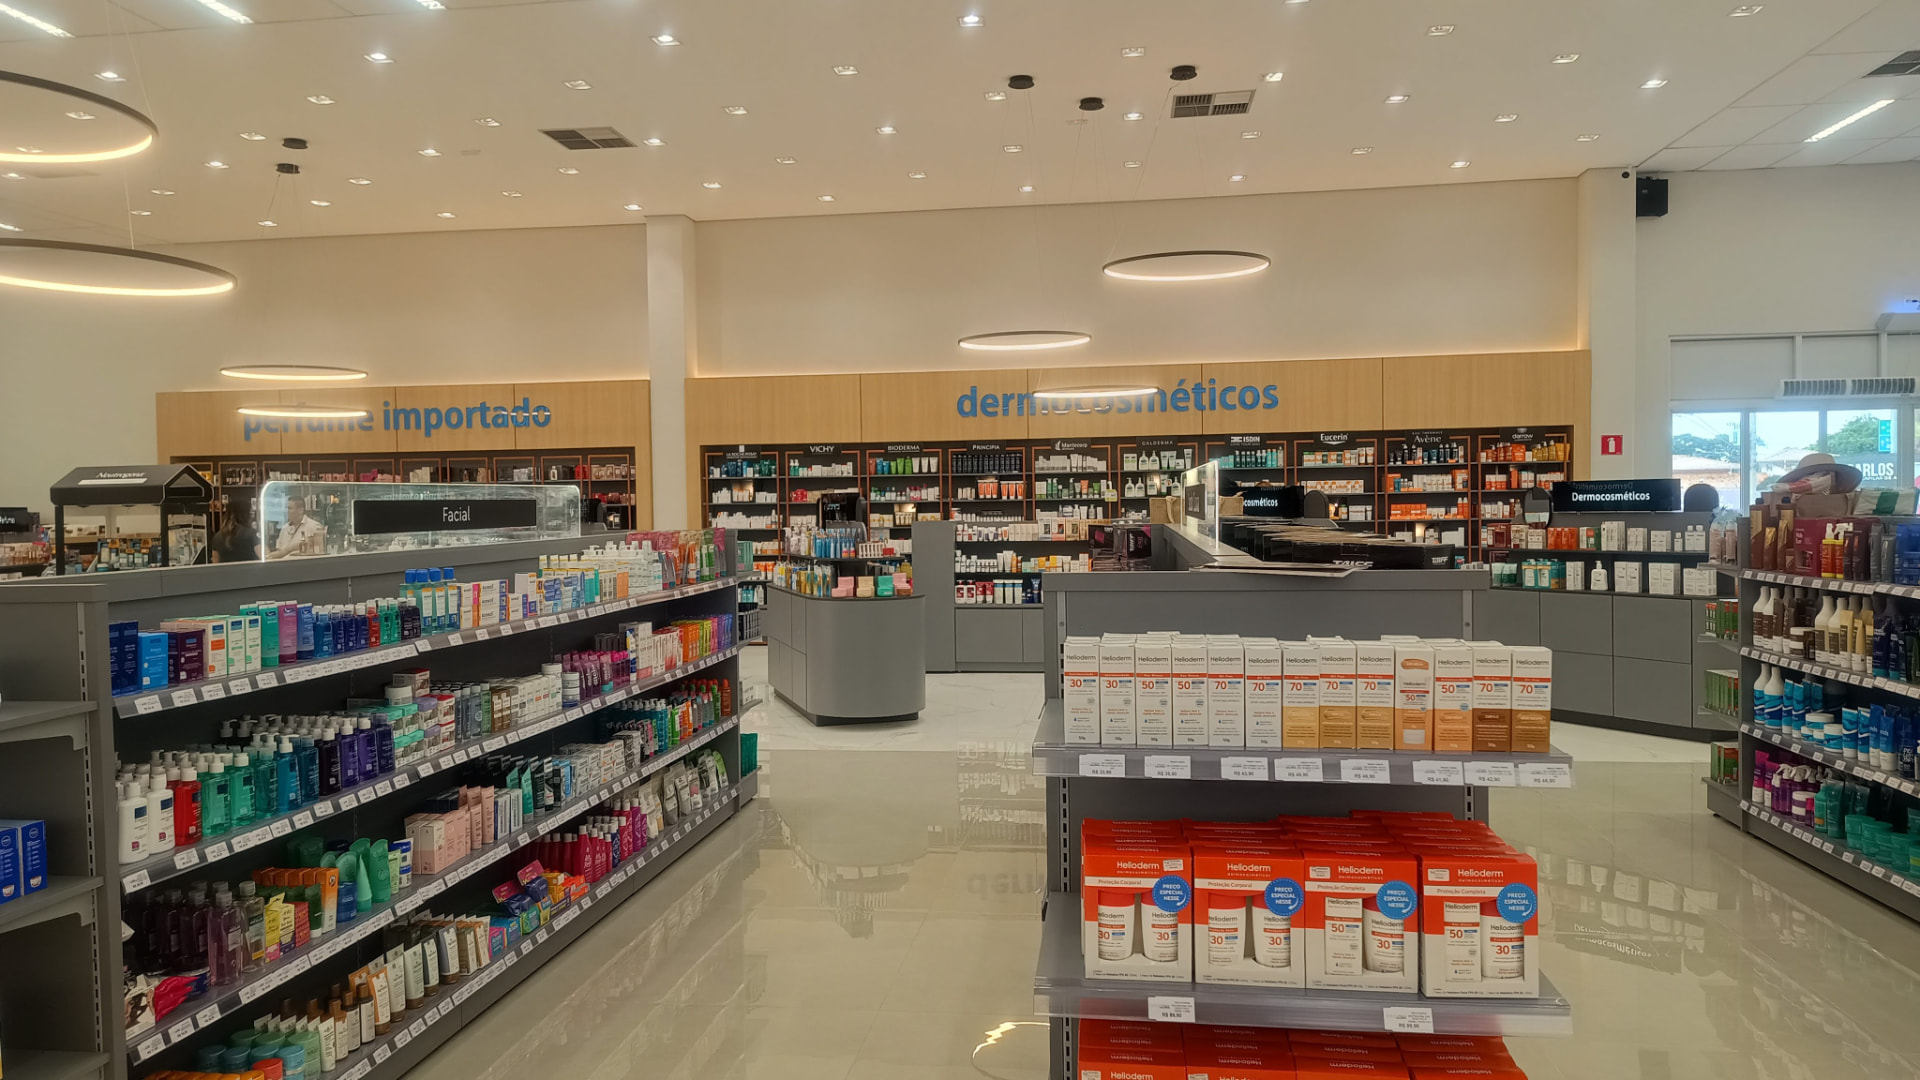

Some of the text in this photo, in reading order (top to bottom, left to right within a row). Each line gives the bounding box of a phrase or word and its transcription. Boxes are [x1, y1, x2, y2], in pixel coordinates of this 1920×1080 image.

[383, 397, 551, 437] importado
[1320, 432, 1348, 441] Eucerin
[1414, 435, 1442, 443] Avène
[809, 445, 835, 453] VICHY
[1848, 463, 1894, 476] RLOS
[1571, 491, 1651, 502] Dermocosméticos
[1243, 497, 1279, 507] cosméticos
[442, 505, 471, 522] Facial
[1069, 679, 1082, 688] 30
[1105, 680, 1118, 689] 30
[1141, 681, 1154, 690] 50
[1177, 681, 1191, 690] 50
[1215, 681, 1227, 690] 70
[1252, 682, 1265, 692] 70
[1290, 682, 1302, 691] 70
[1326, 681, 1339, 690] 70
[1364, 681, 1376, 690] 70
[1480, 683, 1493, 692] 70
[1441, 684, 1455, 694] 50
[1519, 685, 1533, 694] 70
[1117, 861, 1160, 870] Helioderm
[1227, 863, 1271, 872] Helioderm
[1338, 866, 1384, 875] Helioderm
[1457, 869, 1504, 877] Helioderm
[1331, 923, 1345, 933] 50
[1098, 931, 1110, 940] 30
[1156, 932, 1169, 941] 30
[1449, 929, 1463, 939] 50
[1209, 936, 1223, 945] 30
[1268, 937, 1282, 946] 30
[1376, 940, 1391, 950] 30
[1495, 945, 1510, 955] 30
